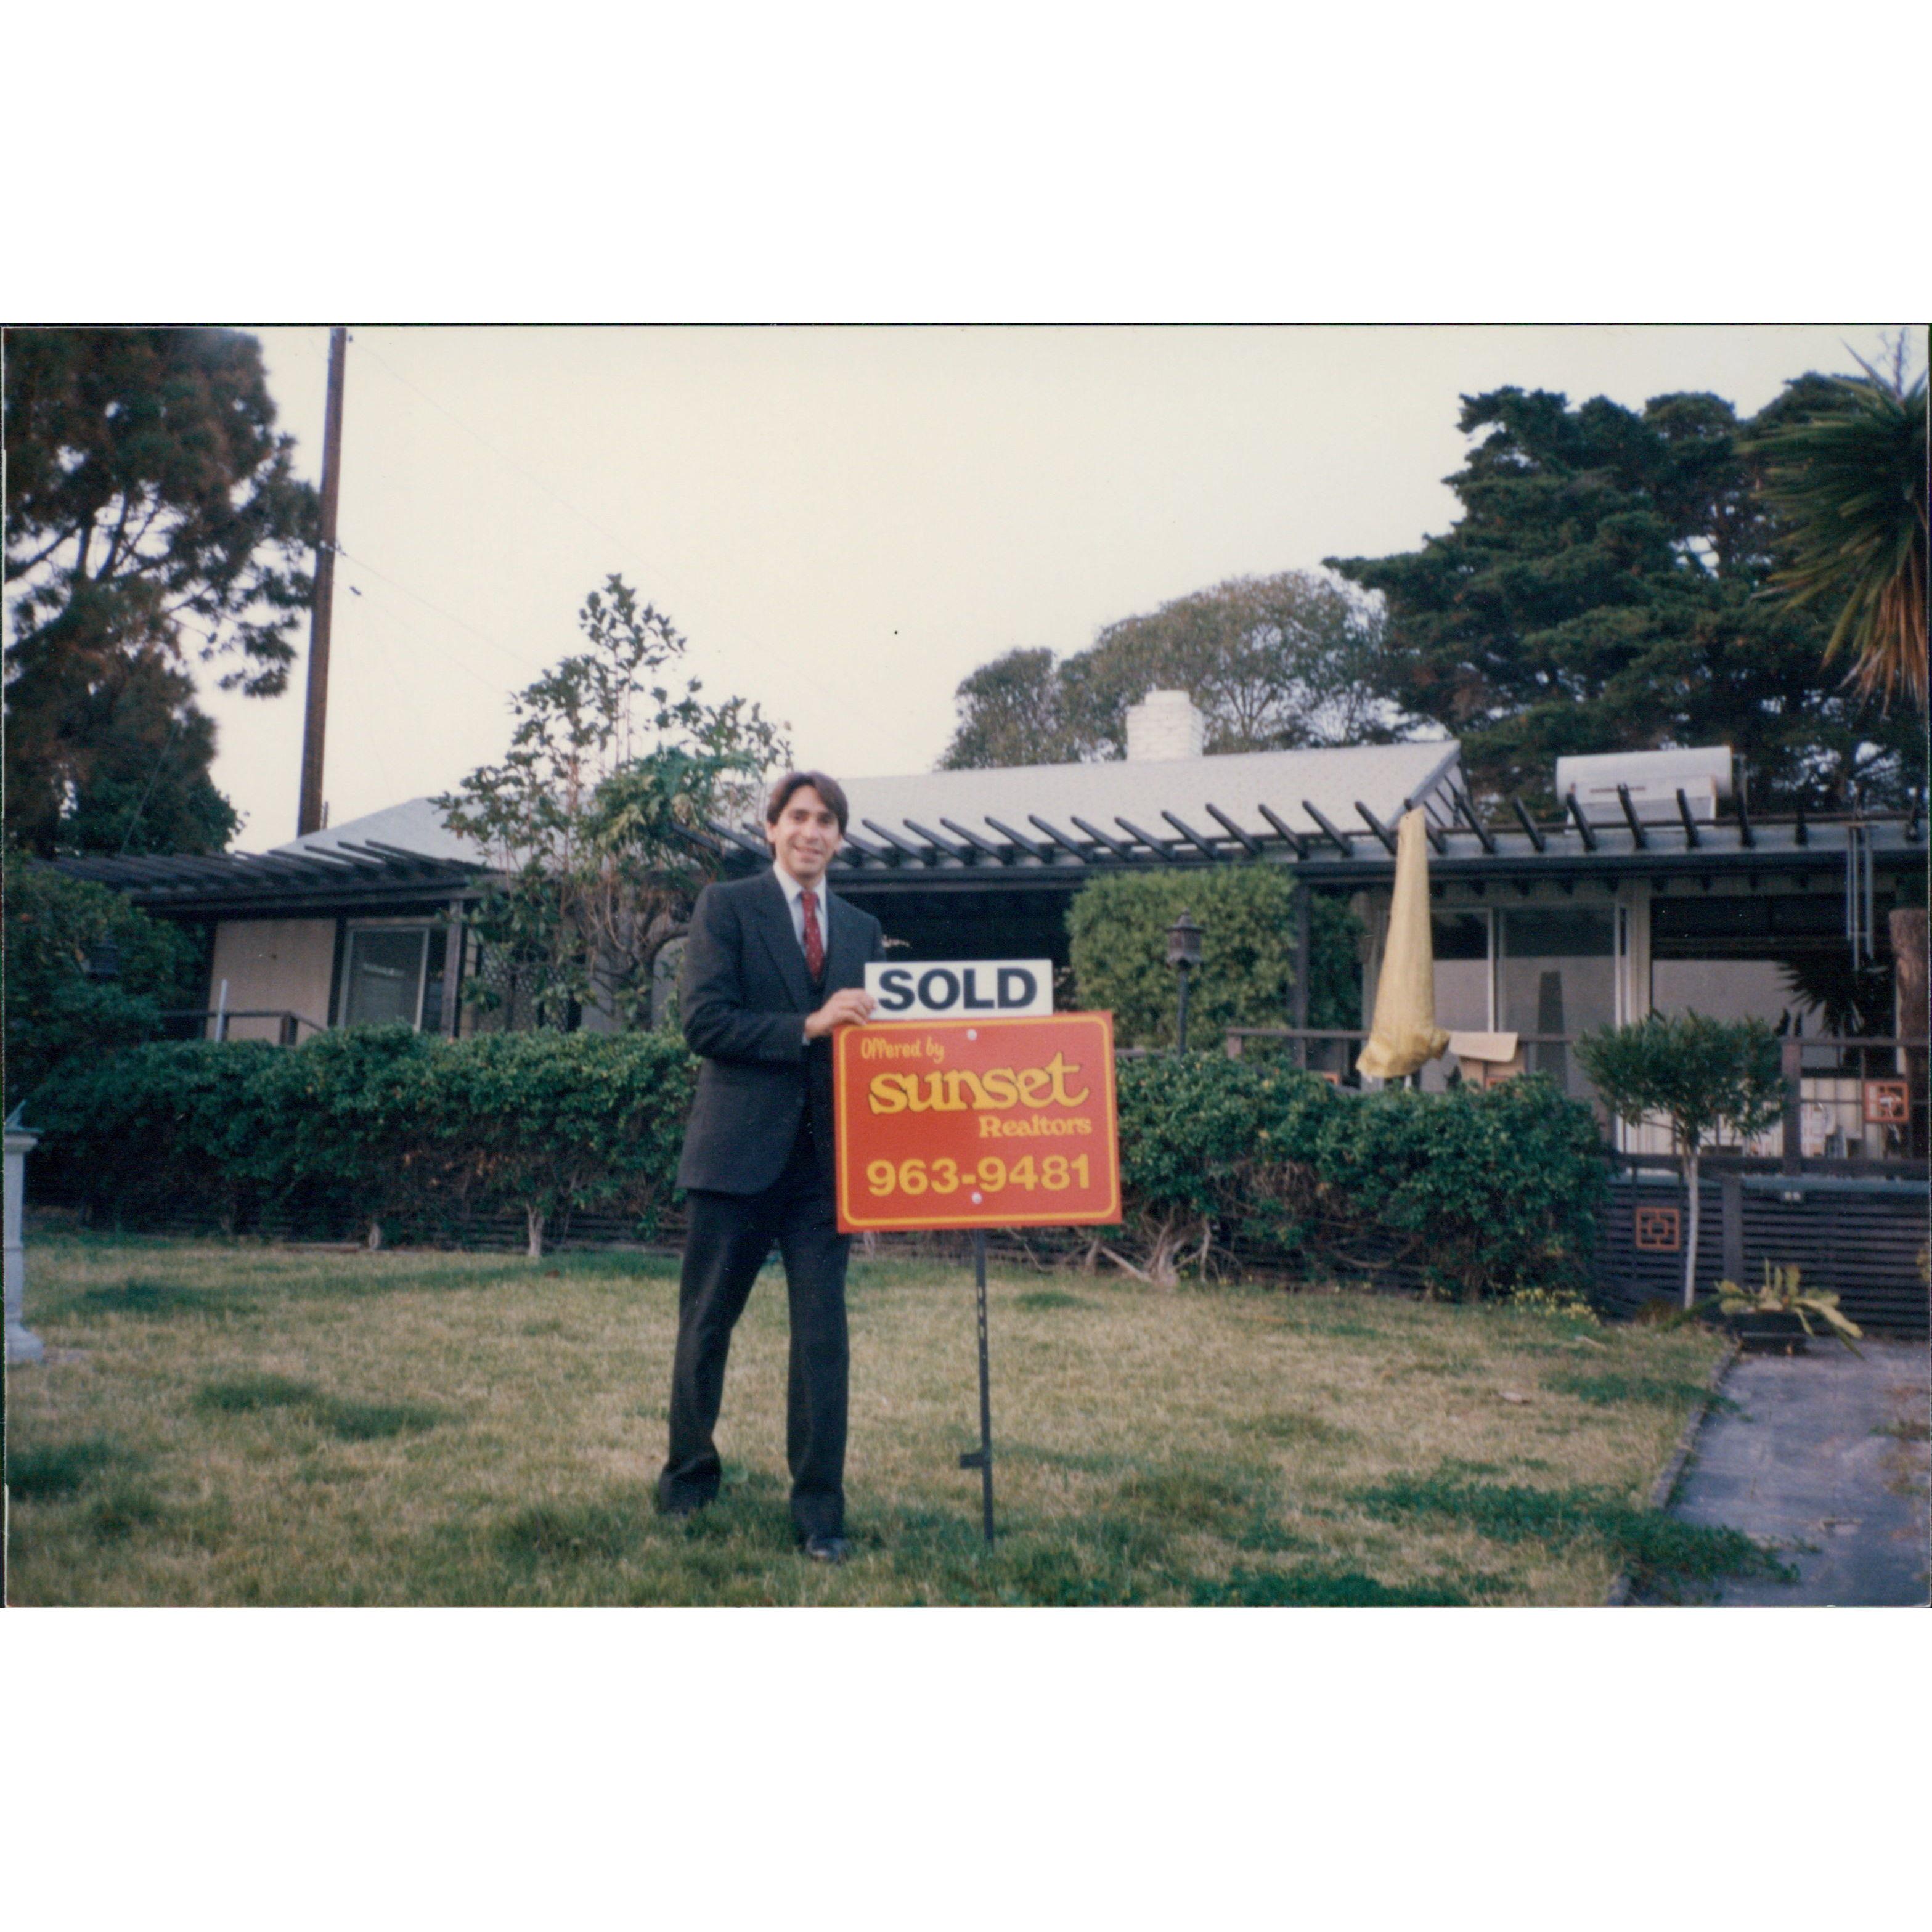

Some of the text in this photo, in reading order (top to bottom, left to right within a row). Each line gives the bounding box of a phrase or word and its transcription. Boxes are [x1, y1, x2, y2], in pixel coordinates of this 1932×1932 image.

[878, 968, 1037, 1011] SOLD
[861, 1035, 945, 1064] Offered by
[868, 1051, 1090, 1115] sunset
[979, 1115, 1093, 1138] Realtors
[866, 1154, 1090, 1197] 963-9481
